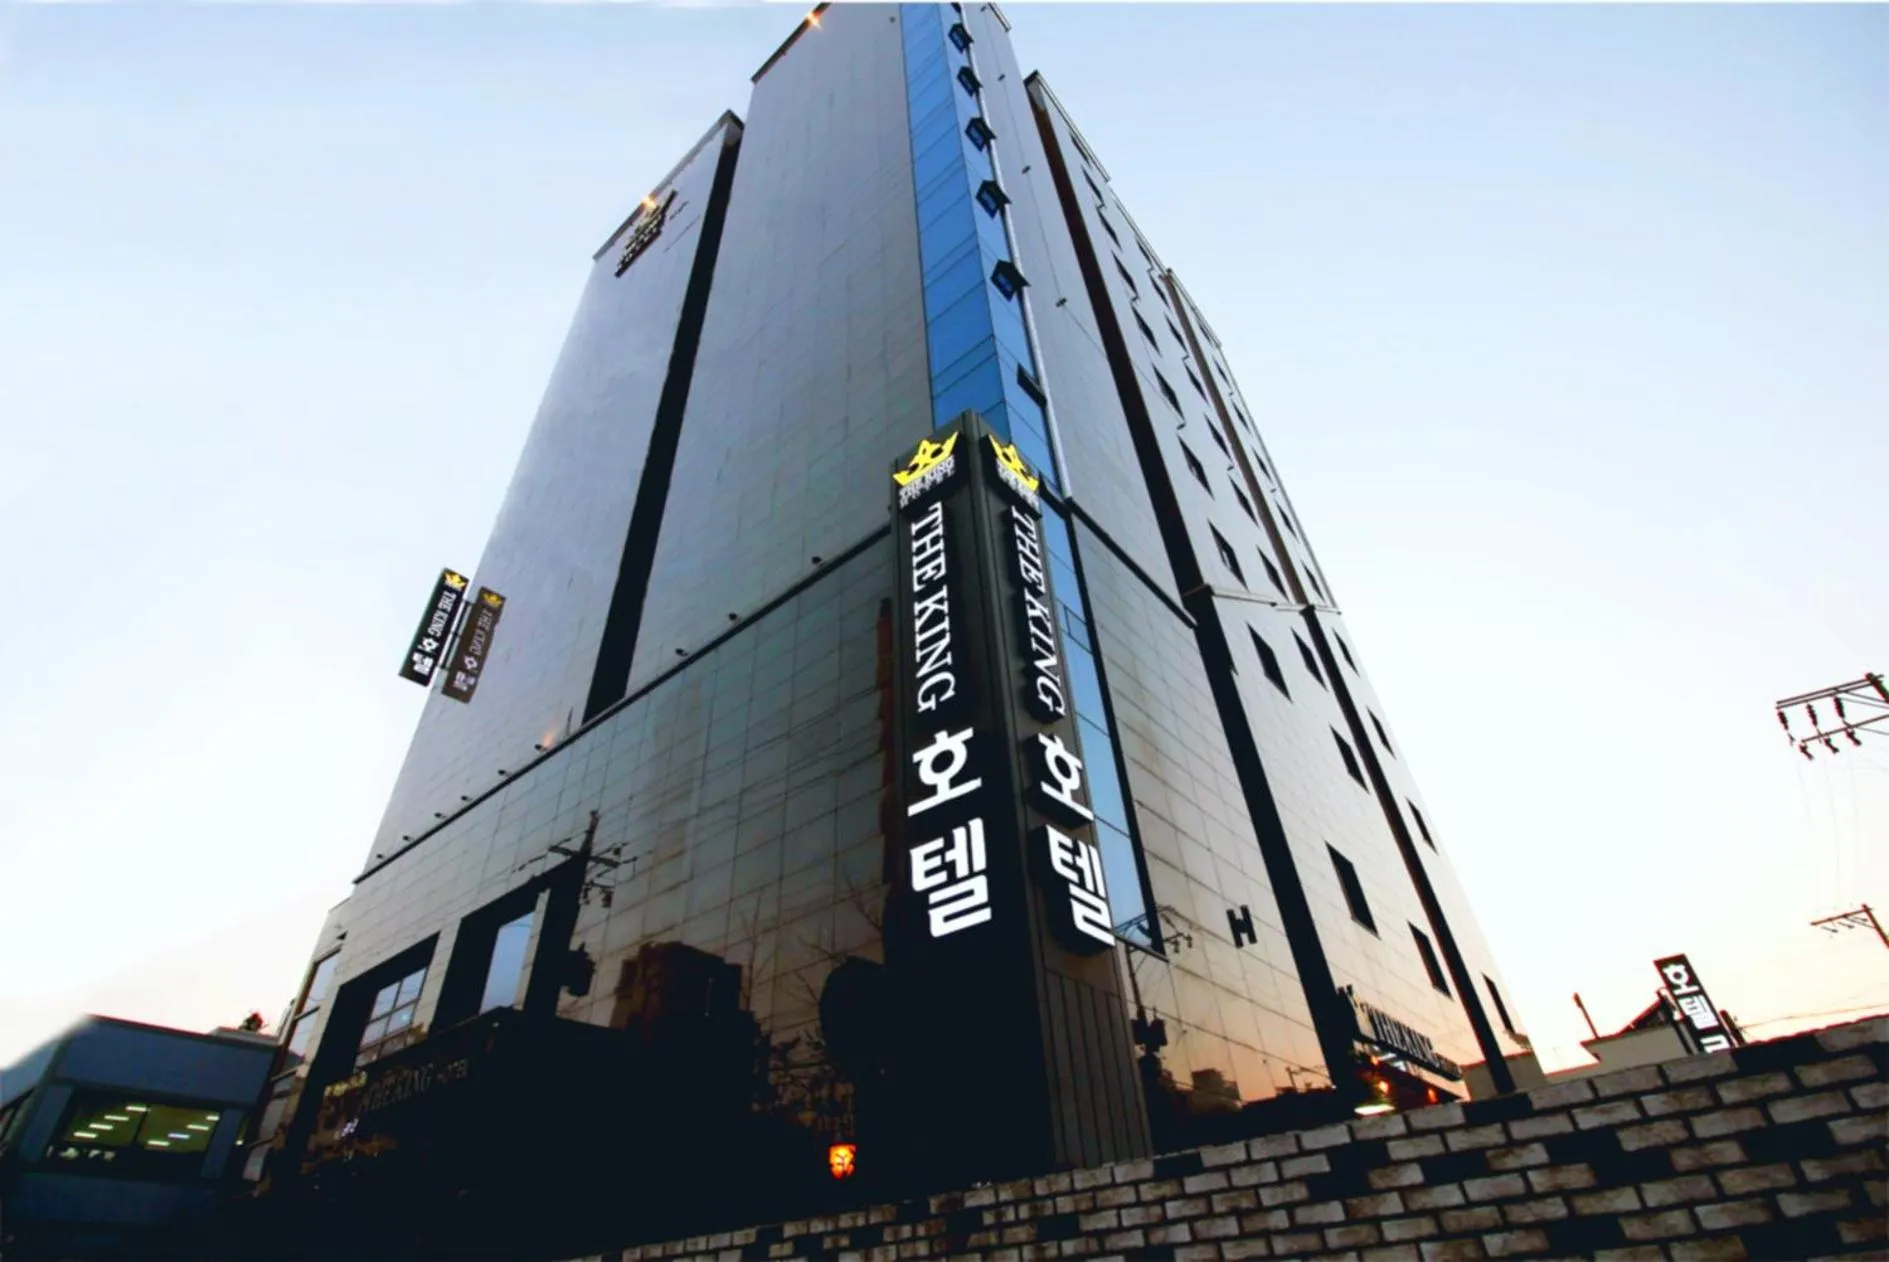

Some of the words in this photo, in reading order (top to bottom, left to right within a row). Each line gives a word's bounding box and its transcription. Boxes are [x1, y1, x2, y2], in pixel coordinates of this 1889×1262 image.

[911, 501, 948, 592] THE
[1011, 505, 1047, 596] THE
[913, 585, 956, 713] KING
[1024, 587, 1067, 718] KING
[907, 726, 992, 938] 호텔
[1038, 732, 1116, 948] 호텔
